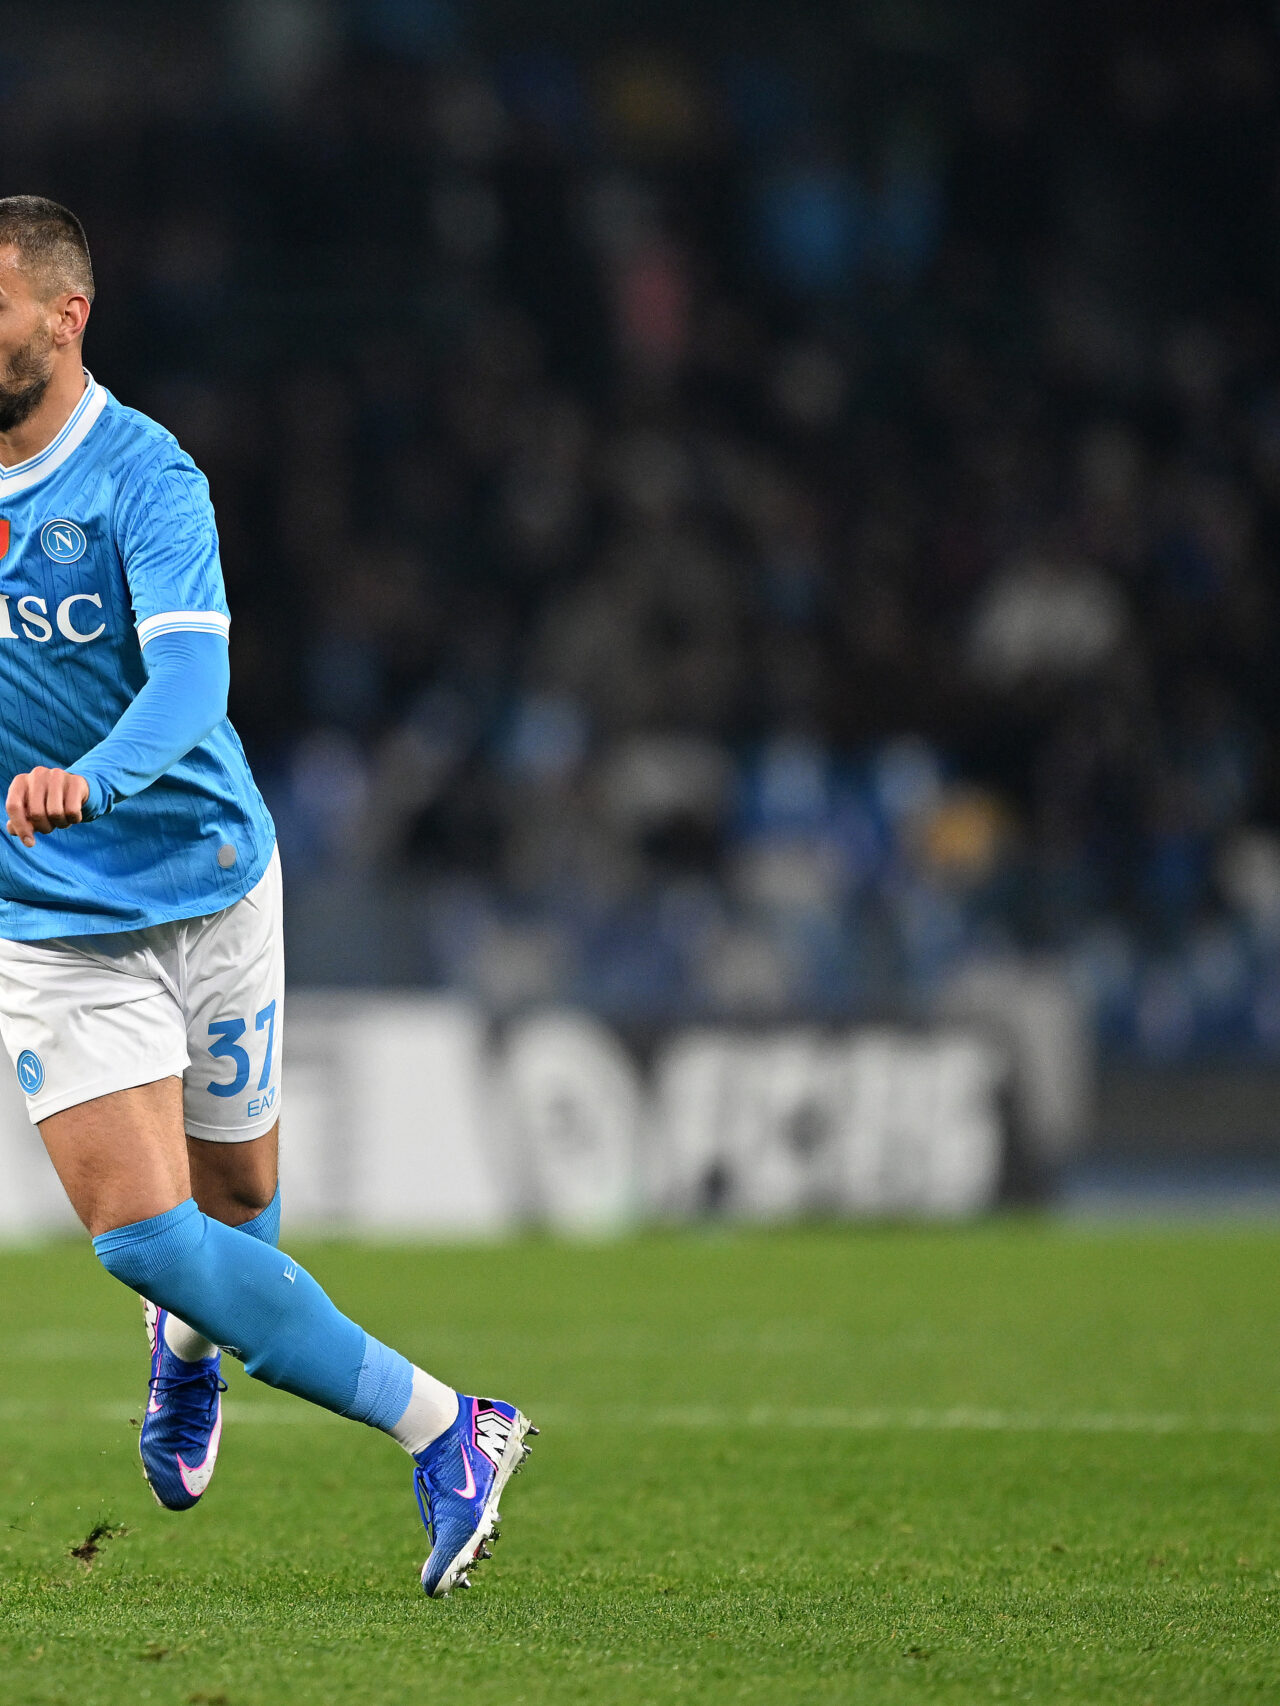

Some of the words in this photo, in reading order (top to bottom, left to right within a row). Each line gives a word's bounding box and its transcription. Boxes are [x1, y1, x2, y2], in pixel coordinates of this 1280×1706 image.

[52, 530, 74, 551] N
[207, 999, 276, 1098] 37
[22, 1059, 38, 1084] N
